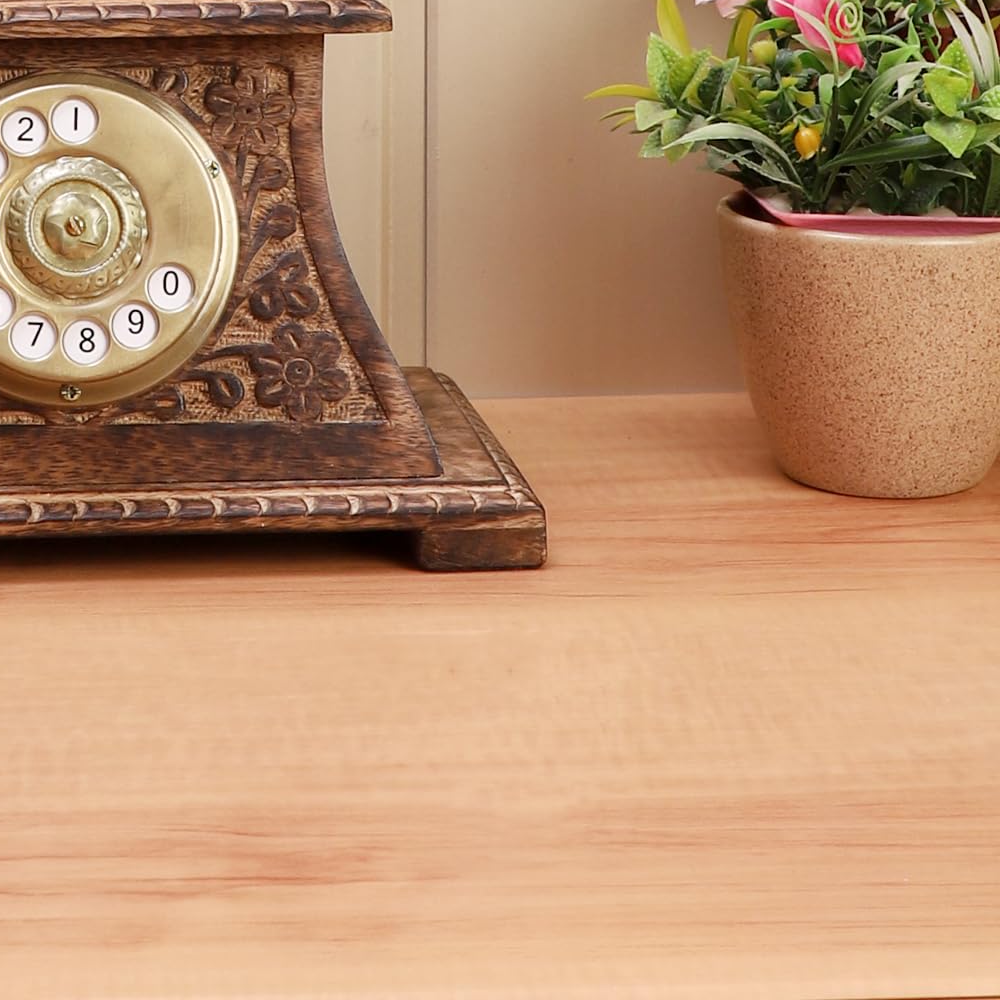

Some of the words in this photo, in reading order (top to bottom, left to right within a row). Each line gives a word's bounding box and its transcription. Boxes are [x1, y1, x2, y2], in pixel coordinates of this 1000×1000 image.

[17, 116, 34, 142] 2
[73, 106, 79, 131] 1
[162, 270, 179, 296] 0
[27, 321, 44, 347] 7
[127, 309, 144, 335] 9
[79, 327, 96, 353] 8
